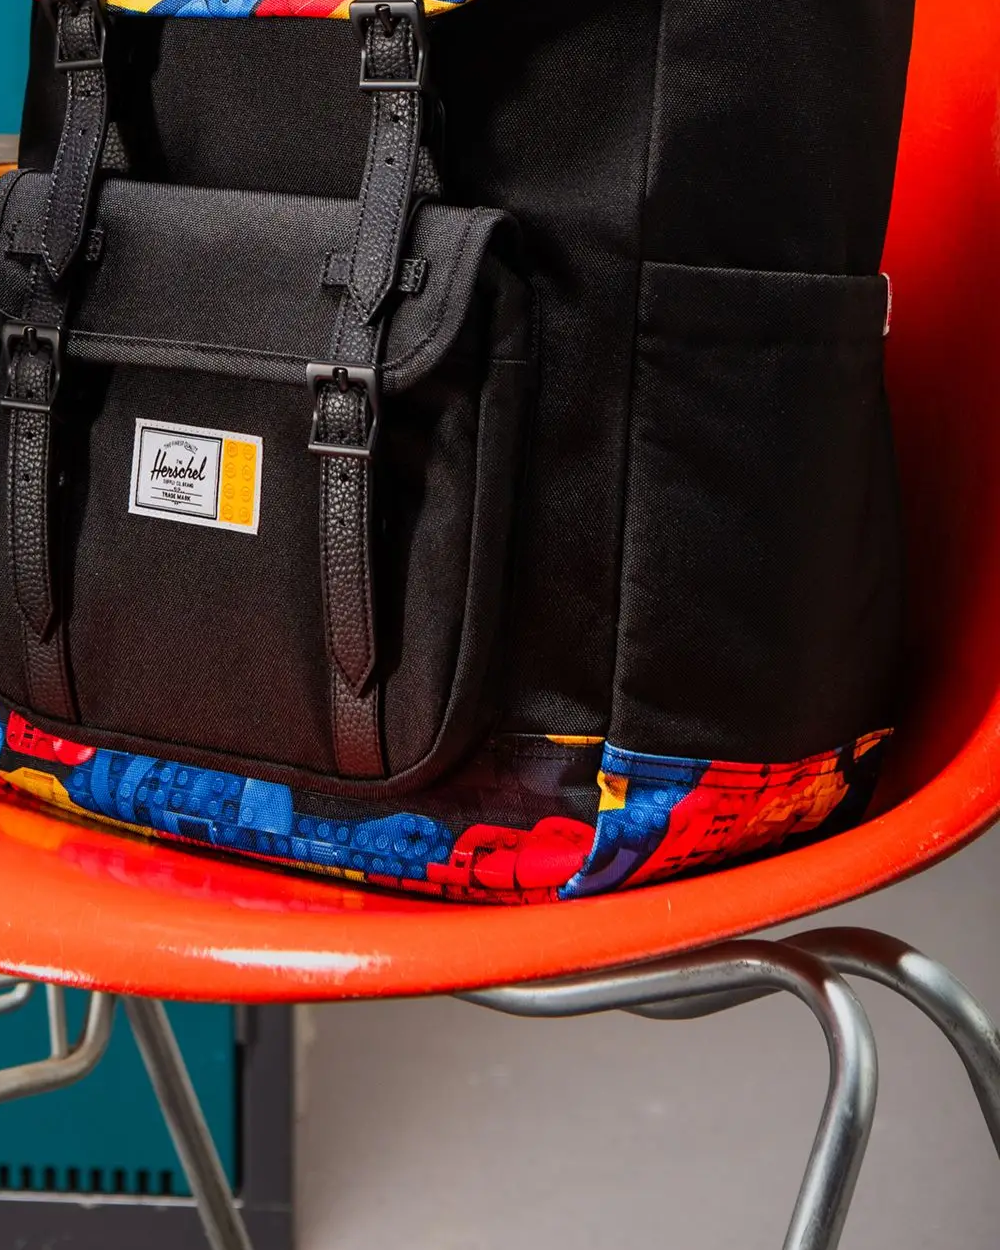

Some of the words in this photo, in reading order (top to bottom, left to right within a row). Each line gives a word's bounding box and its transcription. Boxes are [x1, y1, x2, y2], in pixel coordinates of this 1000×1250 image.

[150, 448, 207, 481] Herschel
[162, 491, 176, 500] TRADE
[177, 494, 191, 502] MARK
